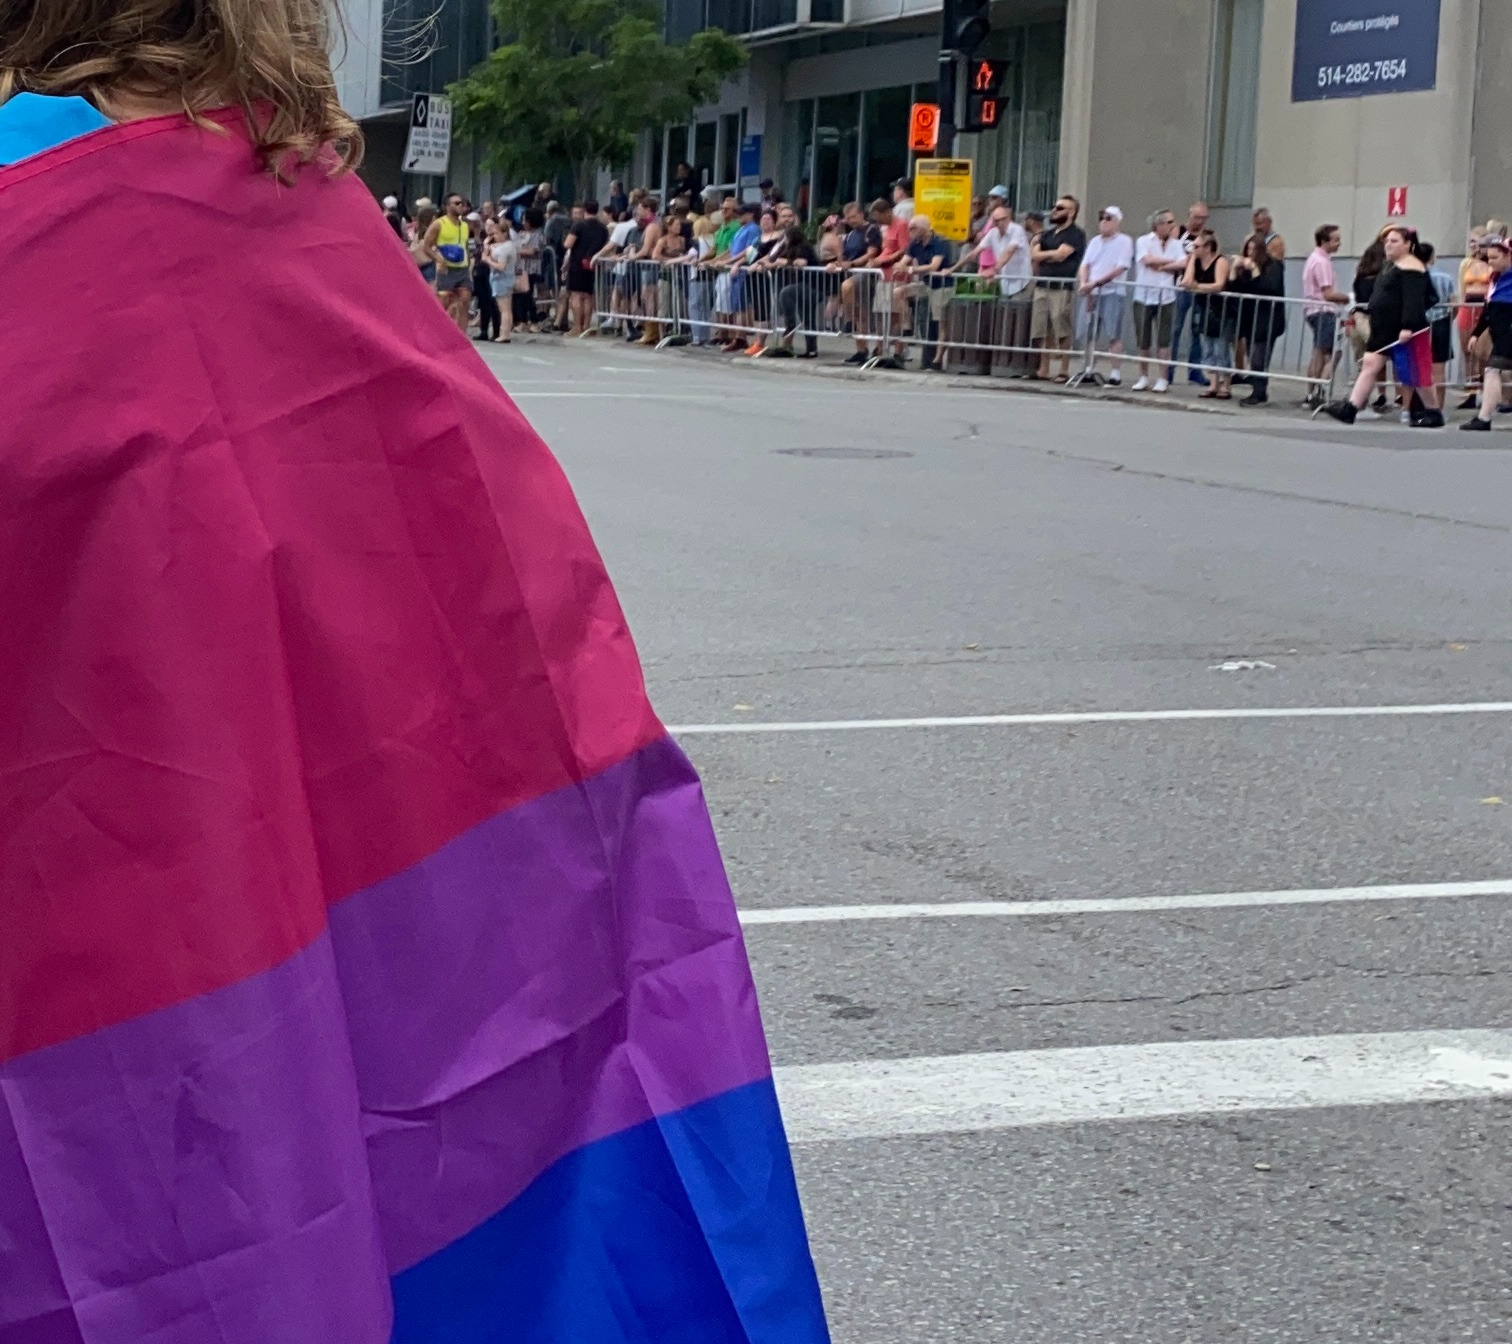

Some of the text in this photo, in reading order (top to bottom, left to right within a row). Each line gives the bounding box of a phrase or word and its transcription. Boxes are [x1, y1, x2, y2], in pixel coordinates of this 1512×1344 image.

[1317, 58, 1407, 87] 514-282-7654
[430, 101, 450, 114] BUS
[430, 117, 450, 129] TAXI
